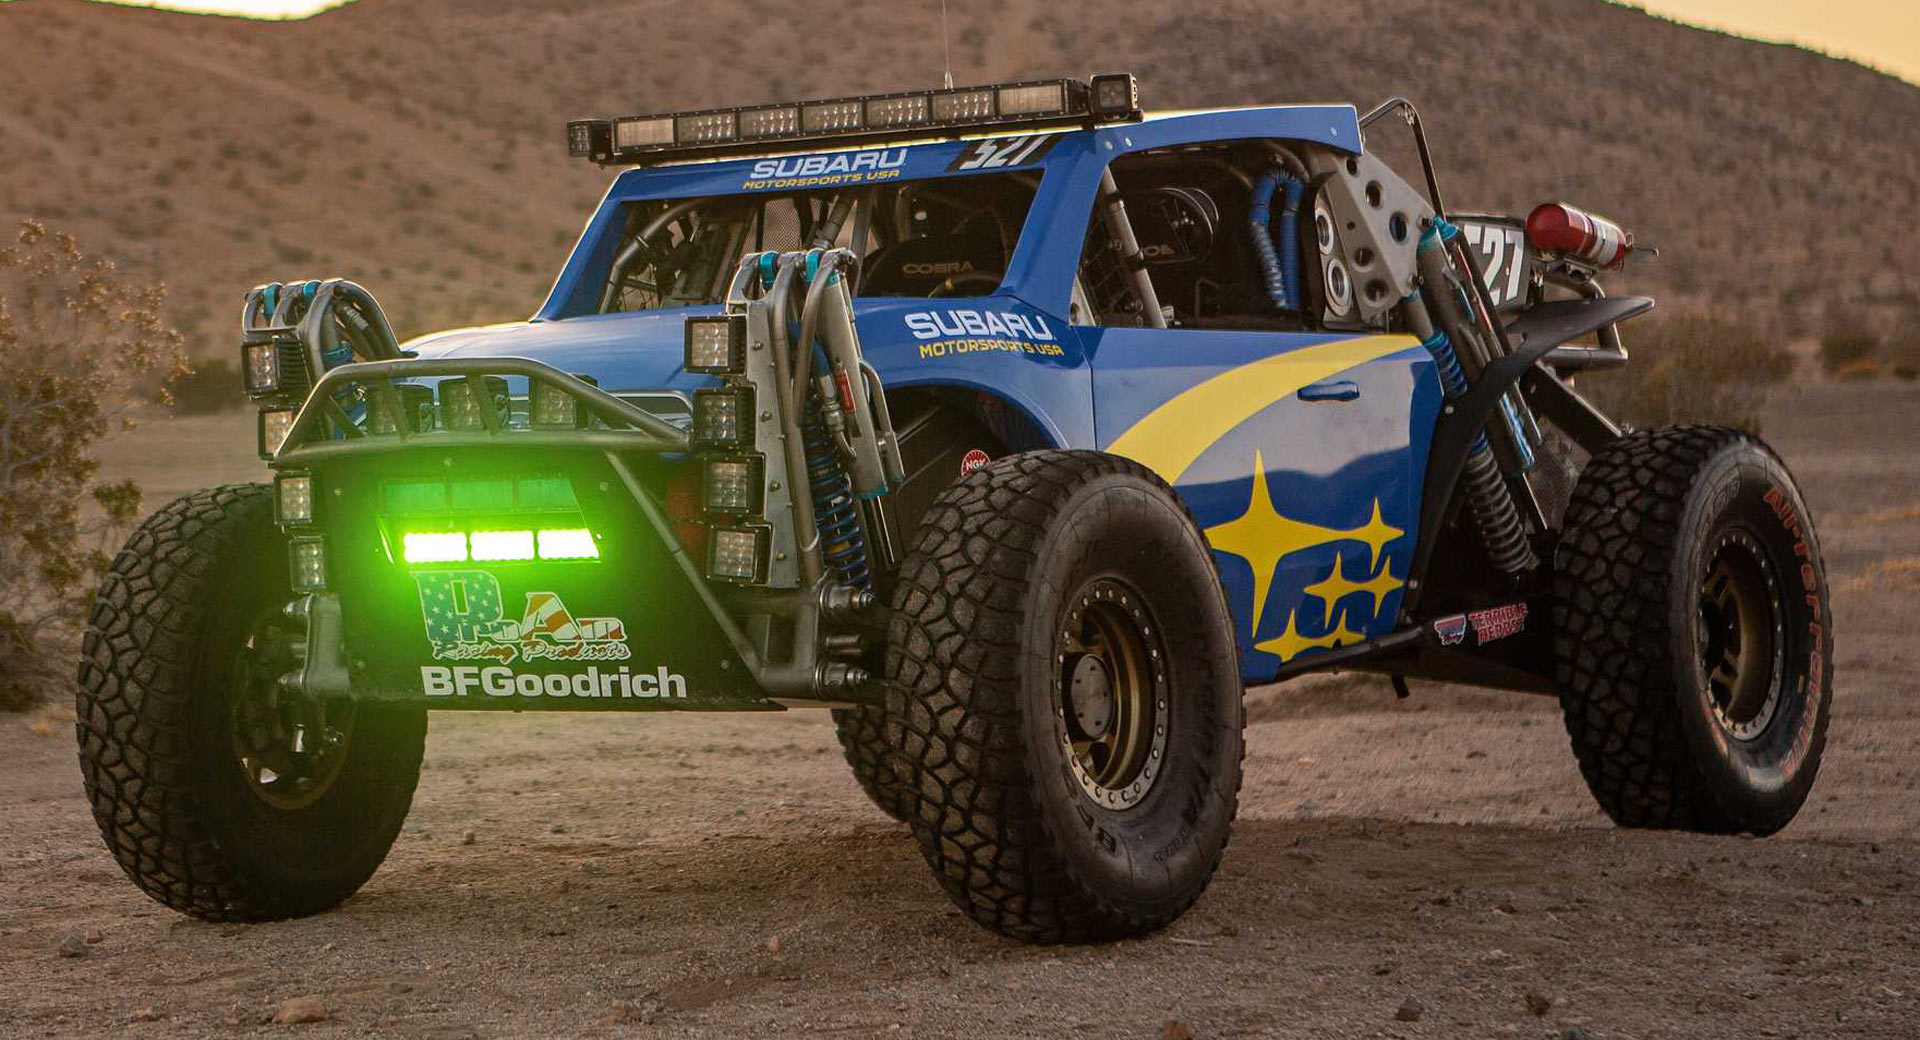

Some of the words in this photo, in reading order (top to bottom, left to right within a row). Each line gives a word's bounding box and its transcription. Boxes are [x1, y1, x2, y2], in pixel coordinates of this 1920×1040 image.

[750, 148, 908, 179] SUBARU
[958, 135, 1050, 170] 527
[742, 173, 863, 190] MOTORSPORTS
[866, 169, 900, 181] USA
[902, 259, 974, 275] COBRA
[1463, 223, 1524, 306] 27
[904, 309, 1055, 341] SUBARU
[919, 338, 1035, 358] MOTORSPORTS
[1036, 342, 1065, 357] USA
[965, 458, 986, 471] NGK
[1468, 602, 1528, 630] TERRIBLE
[1477, 615, 1526, 646] HERBST
[433, 640, 518, 664] Racing
[522, 639, 631, 663] Products
[420, 665, 688, 698] BFGoodrich
